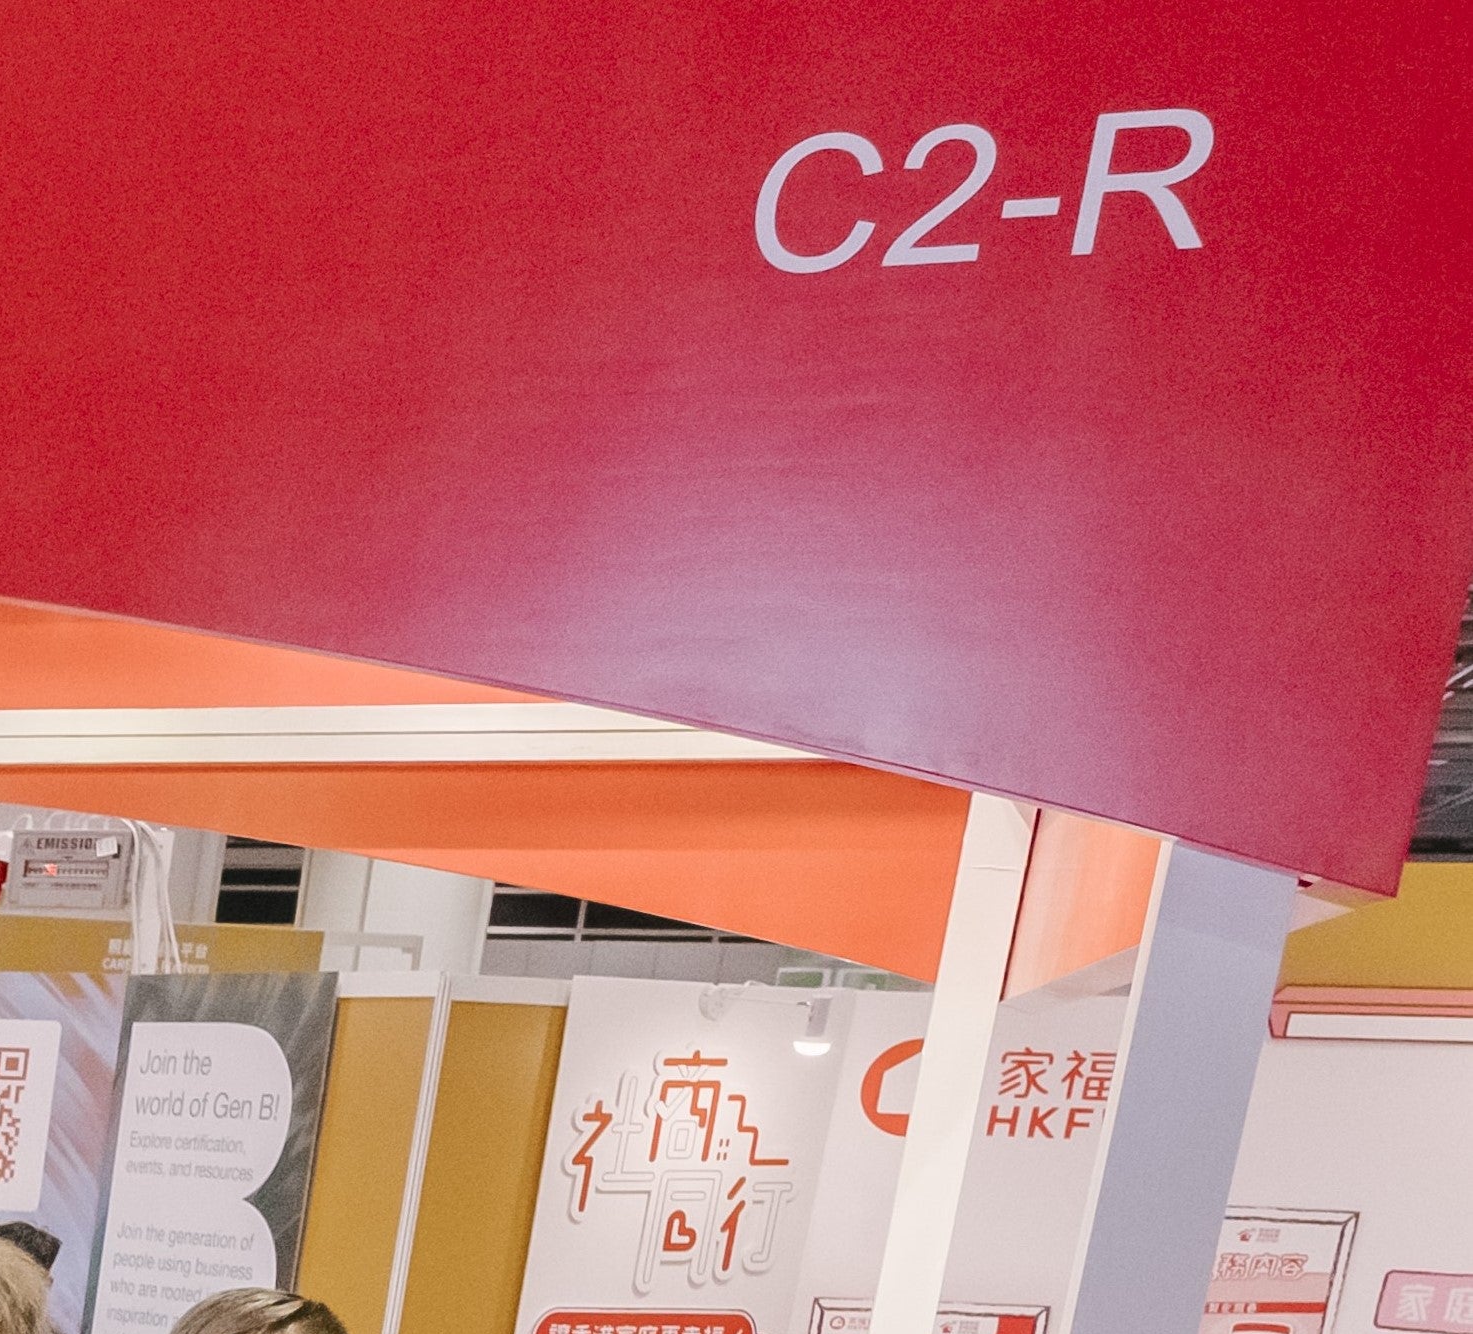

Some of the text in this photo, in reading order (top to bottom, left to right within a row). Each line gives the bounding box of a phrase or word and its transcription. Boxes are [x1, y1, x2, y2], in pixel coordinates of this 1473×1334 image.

[754, 108, 1216, 274] C2-R
[37, 837, 96, 850] EMISSIO
[139, 1049, 212, 1076] Join the
[135, 1090, 280, 1121] world of Gen B!
[986, 1105, 1105, 1139] HKF
[129, 1131, 172, 1149] Explore
[169, 1162, 194, 1177] and
[194, 1165, 254, 1182] resources
[117, 1222, 255, 1251] Join the generation of
[112, 1251, 254, 1281] people using business
[1216, 1253, 1308, 1281] 務內容
[110, 1279, 202, 1304] who are rooted
[107, 1306, 168, 1328] inspiration
